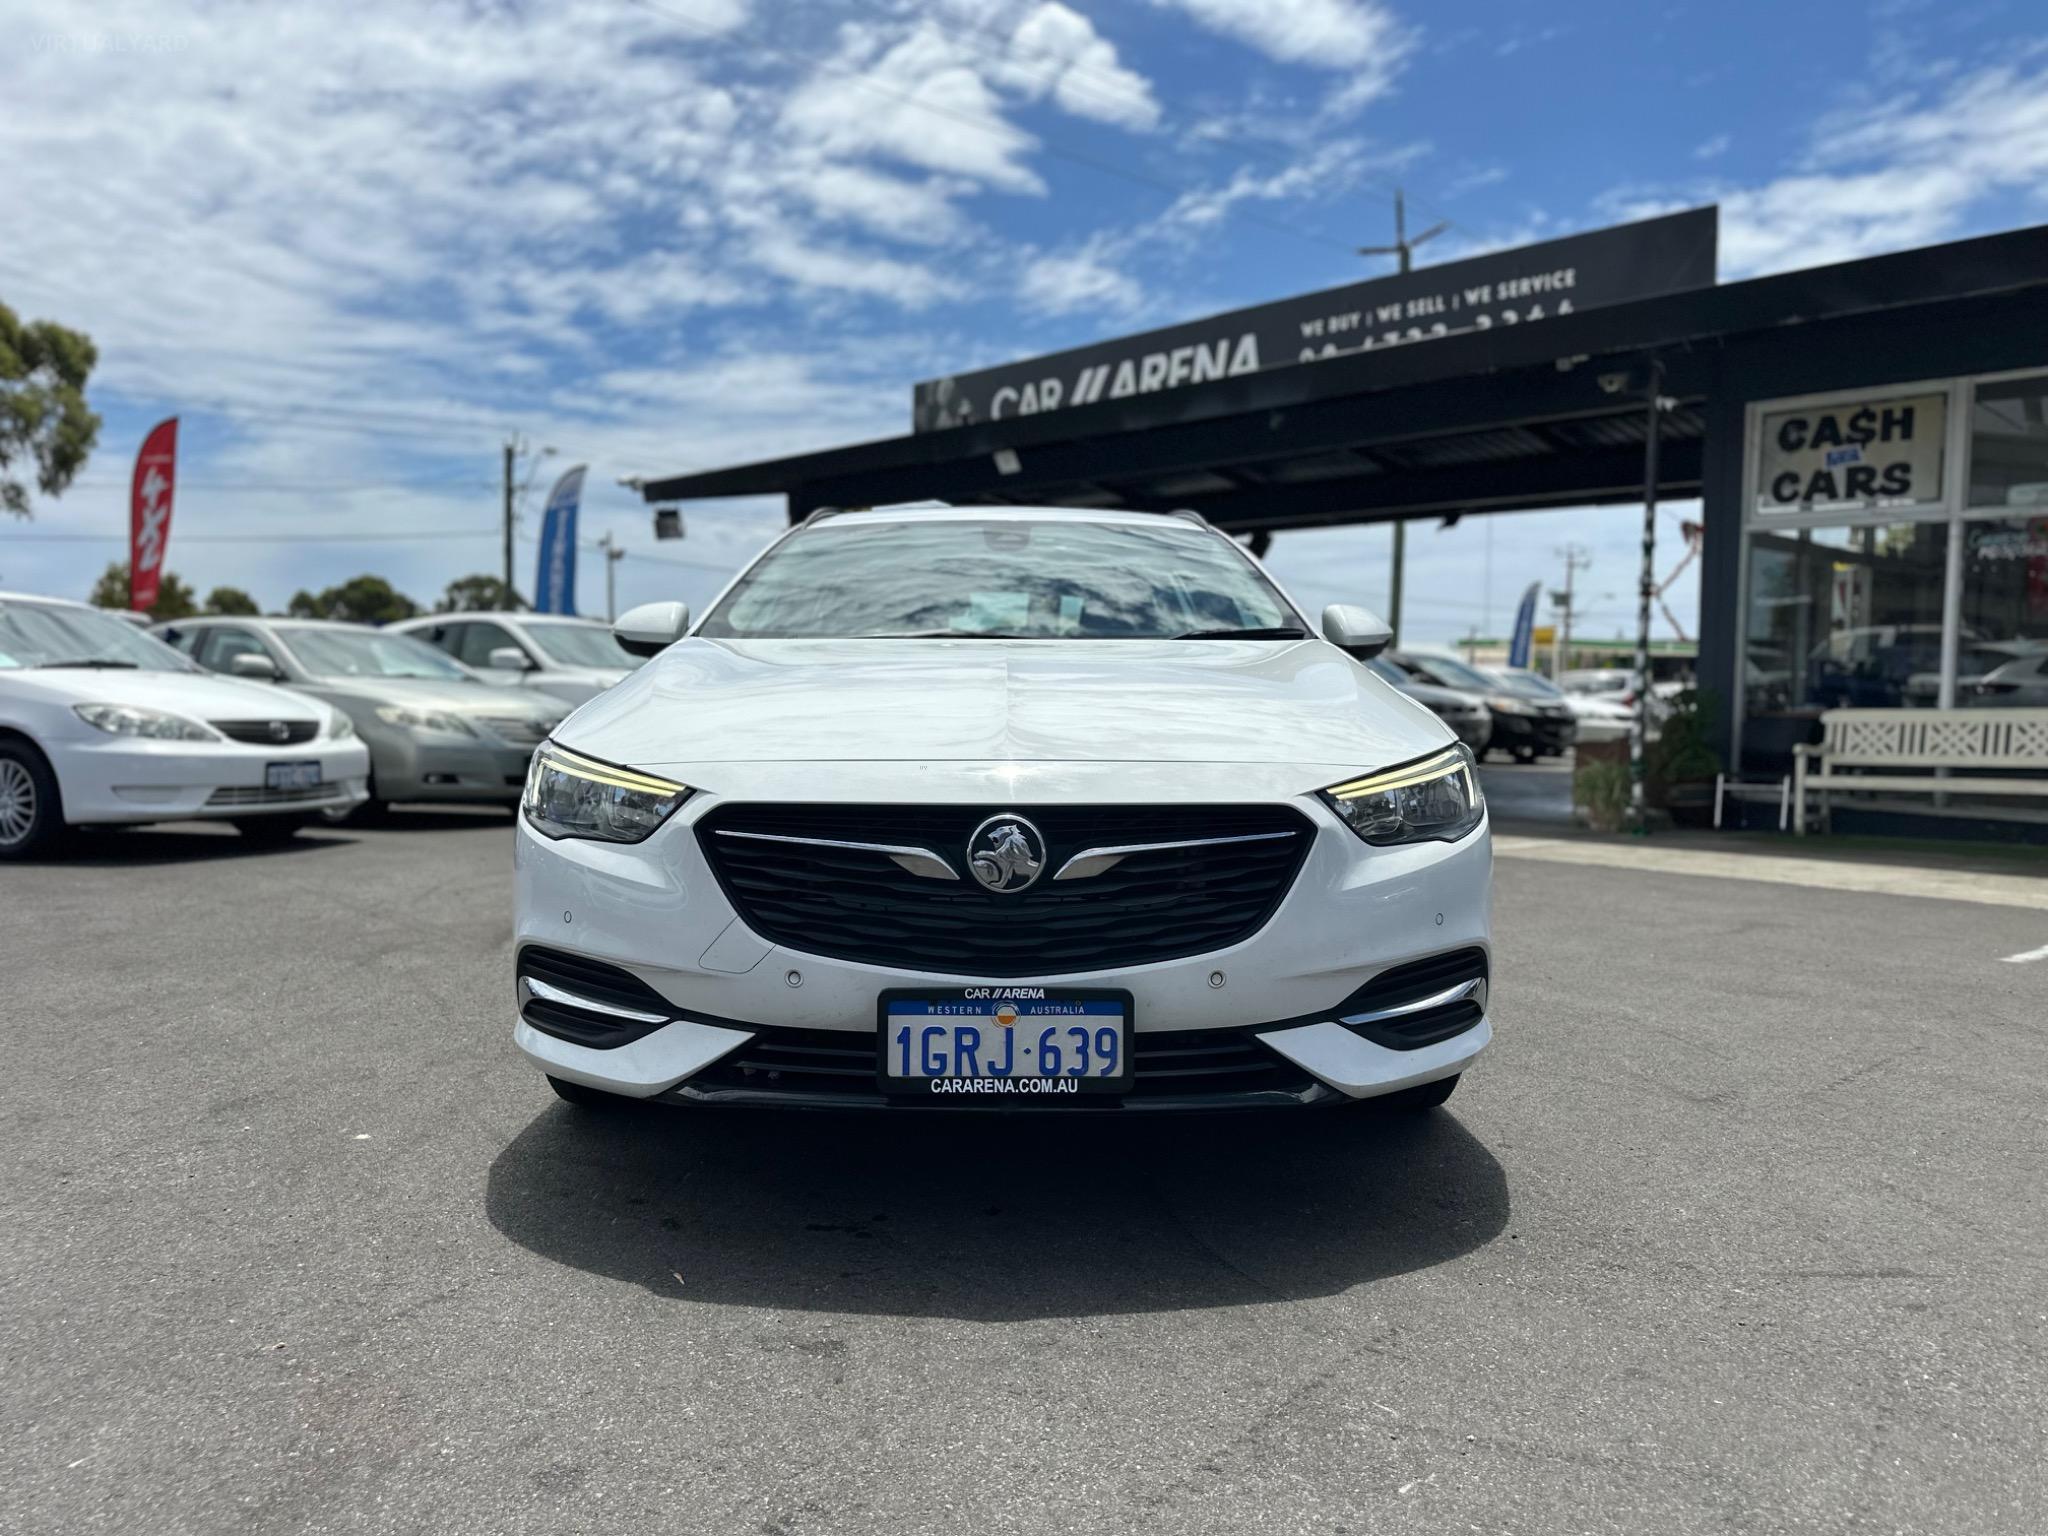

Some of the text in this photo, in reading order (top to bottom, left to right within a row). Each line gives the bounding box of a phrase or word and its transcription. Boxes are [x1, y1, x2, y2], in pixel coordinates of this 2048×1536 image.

[1300, 318, 1325, 338] WE
[1327, 310, 1361, 335] BUY
[1376, 302, 1402, 323] WE
[1406, 294, 1446, 319] SELL
[1463, 284, 1491, 307] WE
[1496, 267, 1577, 301] SERVICE
[988, 377, 1064, 422] CAR
[1772, 462, 1913, 502] CARS
[964, 988, 991, 999] CAR
[928, 1005, 1085, 1015] WESTERN AUSTRALIA
[931, 1078, 1078, 1093] CARARENA.COM.AU
